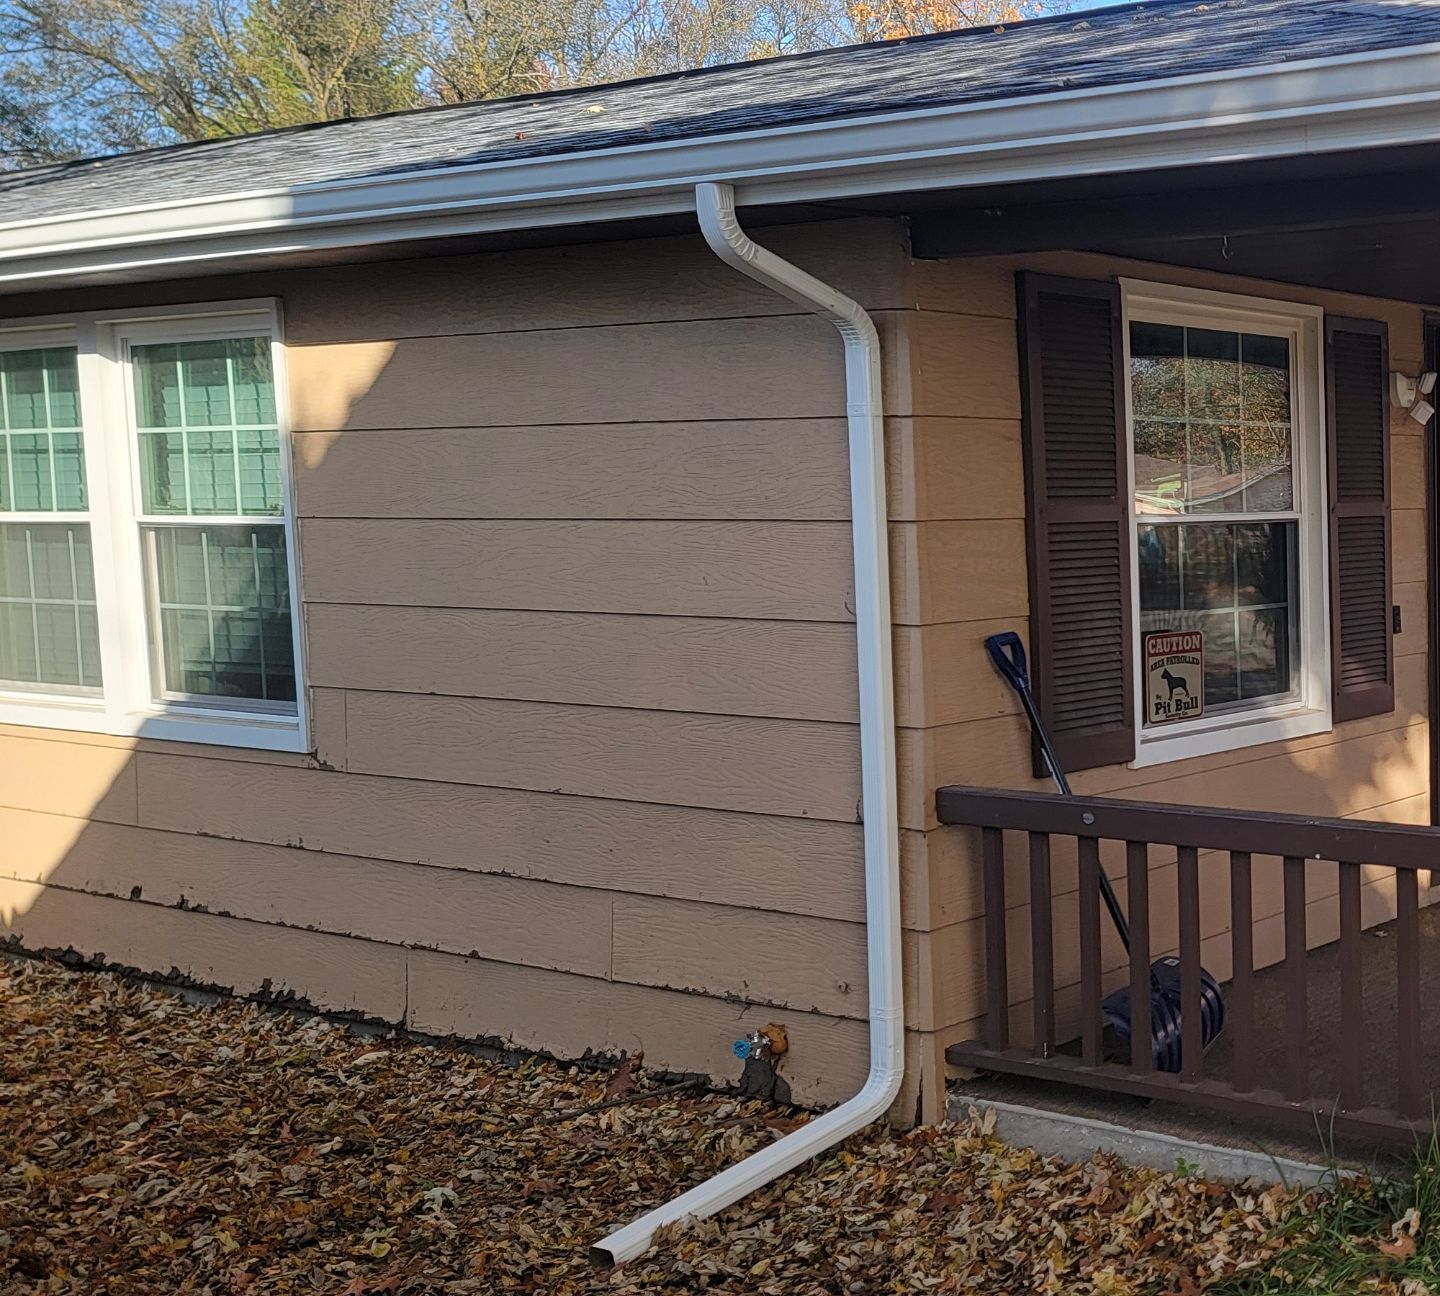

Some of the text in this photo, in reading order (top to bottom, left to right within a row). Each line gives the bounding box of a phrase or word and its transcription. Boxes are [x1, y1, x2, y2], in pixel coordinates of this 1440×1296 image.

[1148, 635, 1200, 653] CAUTION
[1166, 655, 1200, 665] PATROLLED
[1154, 696, 1198, 715] Pit Bull
